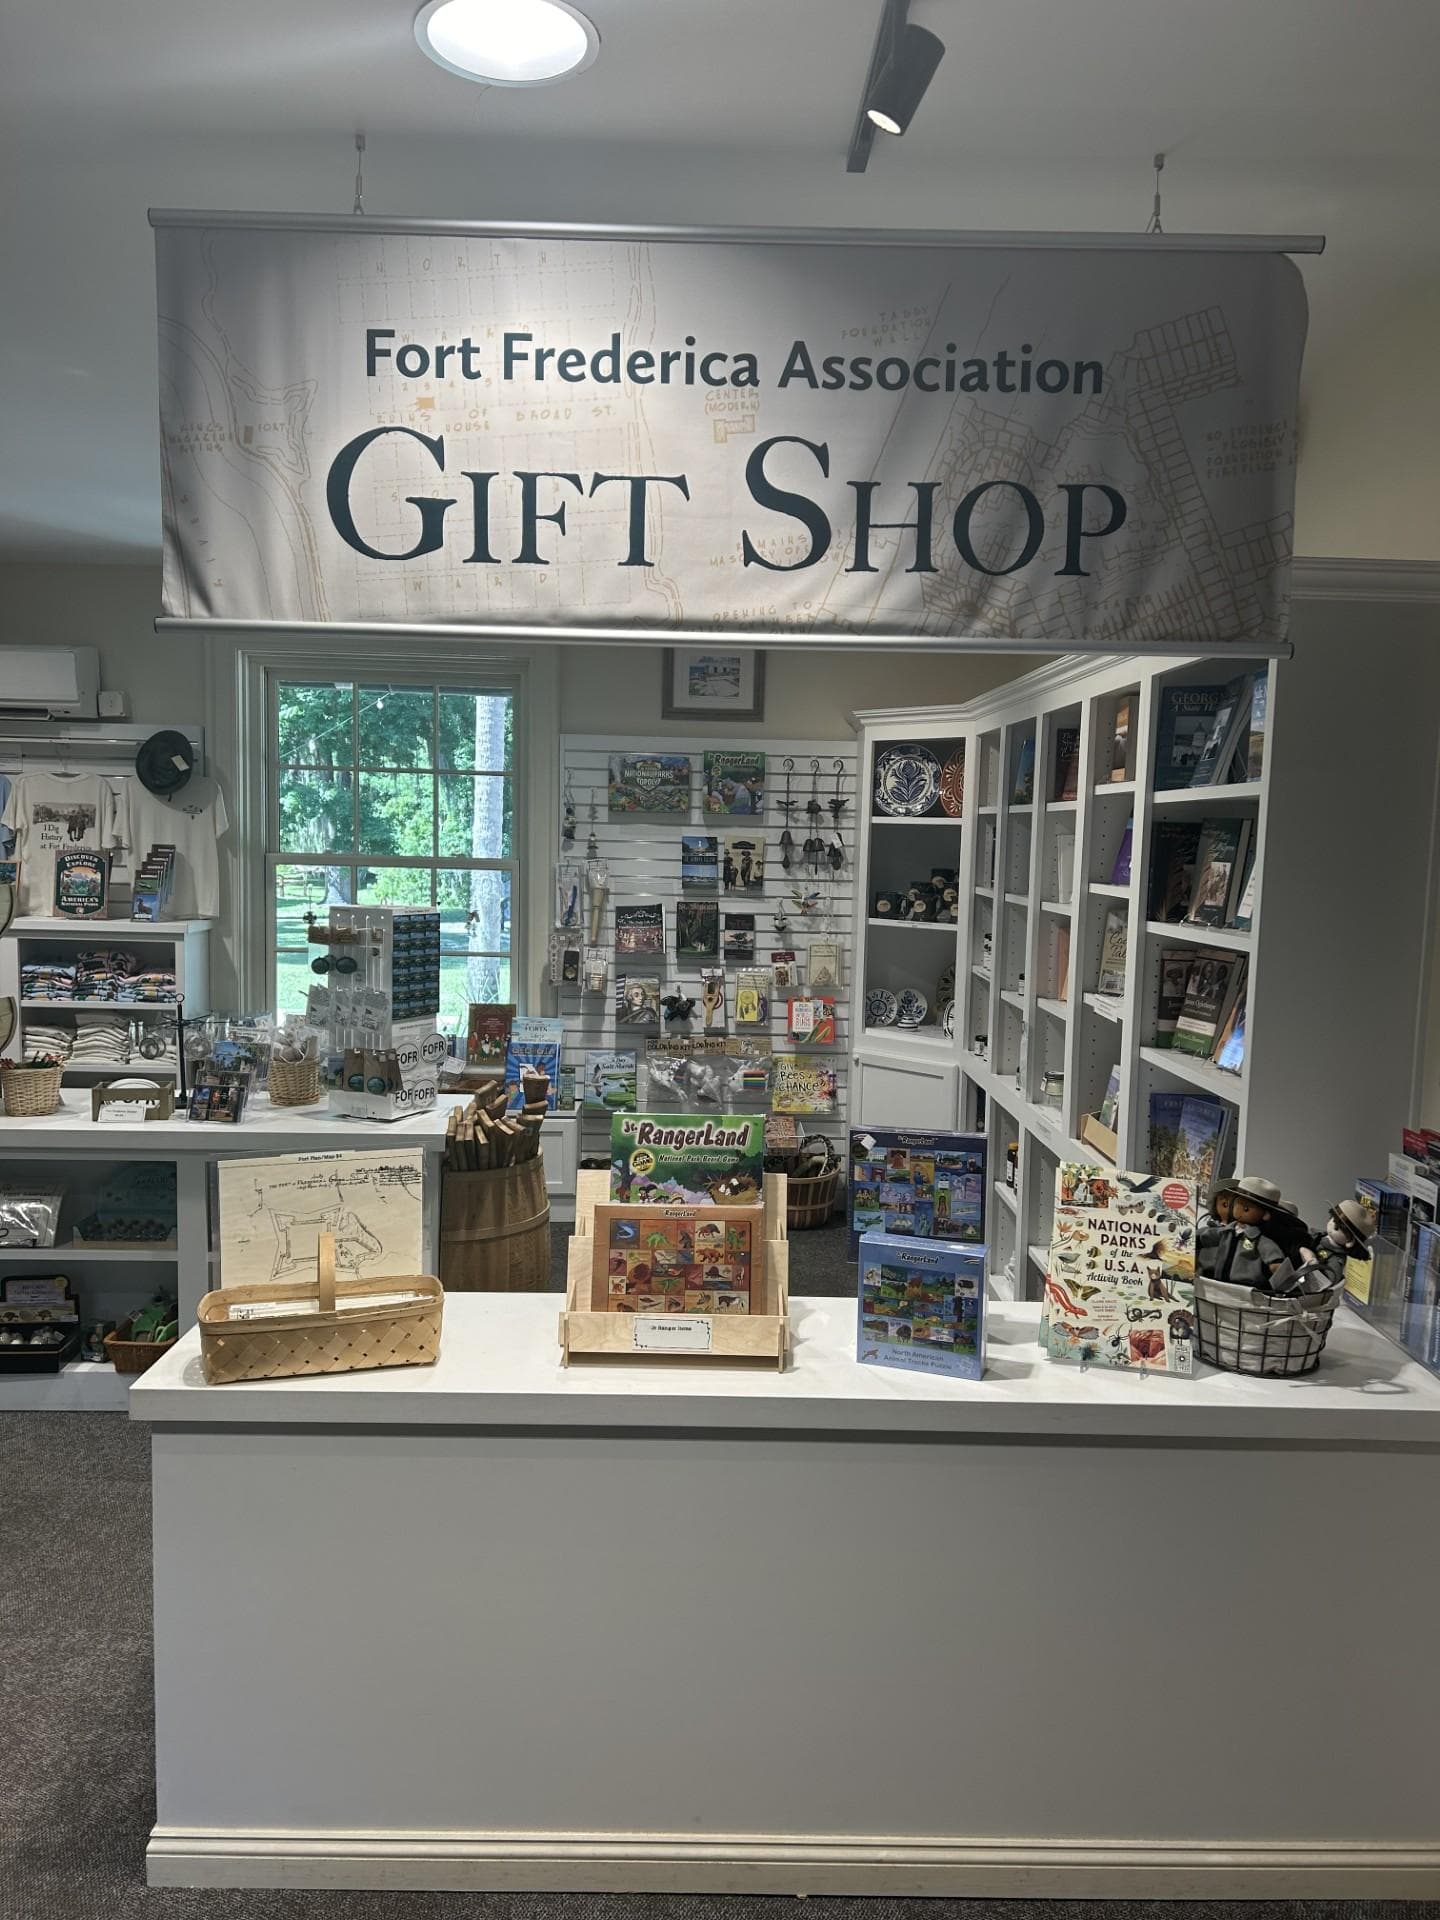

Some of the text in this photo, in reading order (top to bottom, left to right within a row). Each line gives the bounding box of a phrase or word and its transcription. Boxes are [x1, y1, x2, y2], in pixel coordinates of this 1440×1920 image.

[366, 328, 1103, 395] Fort Frederica Association
[326, 426, 1127, 577] GIFT SHOP
[65, 854, 98, 863] DISCOVER
[422, 1040, 444, 1056] FOFR
[395, 1088, 412, 1103] FOF
[414, 1087, 435, 1100] FOFR
[624, 1120, 638, 1133] Jr.
[637, 1121, 750, 1151] RangerLand
[659, 1154, 684, 1163] National
[1088, 1218, 1161, 1237] NATIONAL
[1100, 1233, 1146, 1249] PARKS
[1110, 1248, 1133, 1258] of the
[1104, 1259, 1144, 1275] U.S.A.
[1087, 1272, 1143, 1286] Activity Book
[893, 1348, 944, 1361] North American
